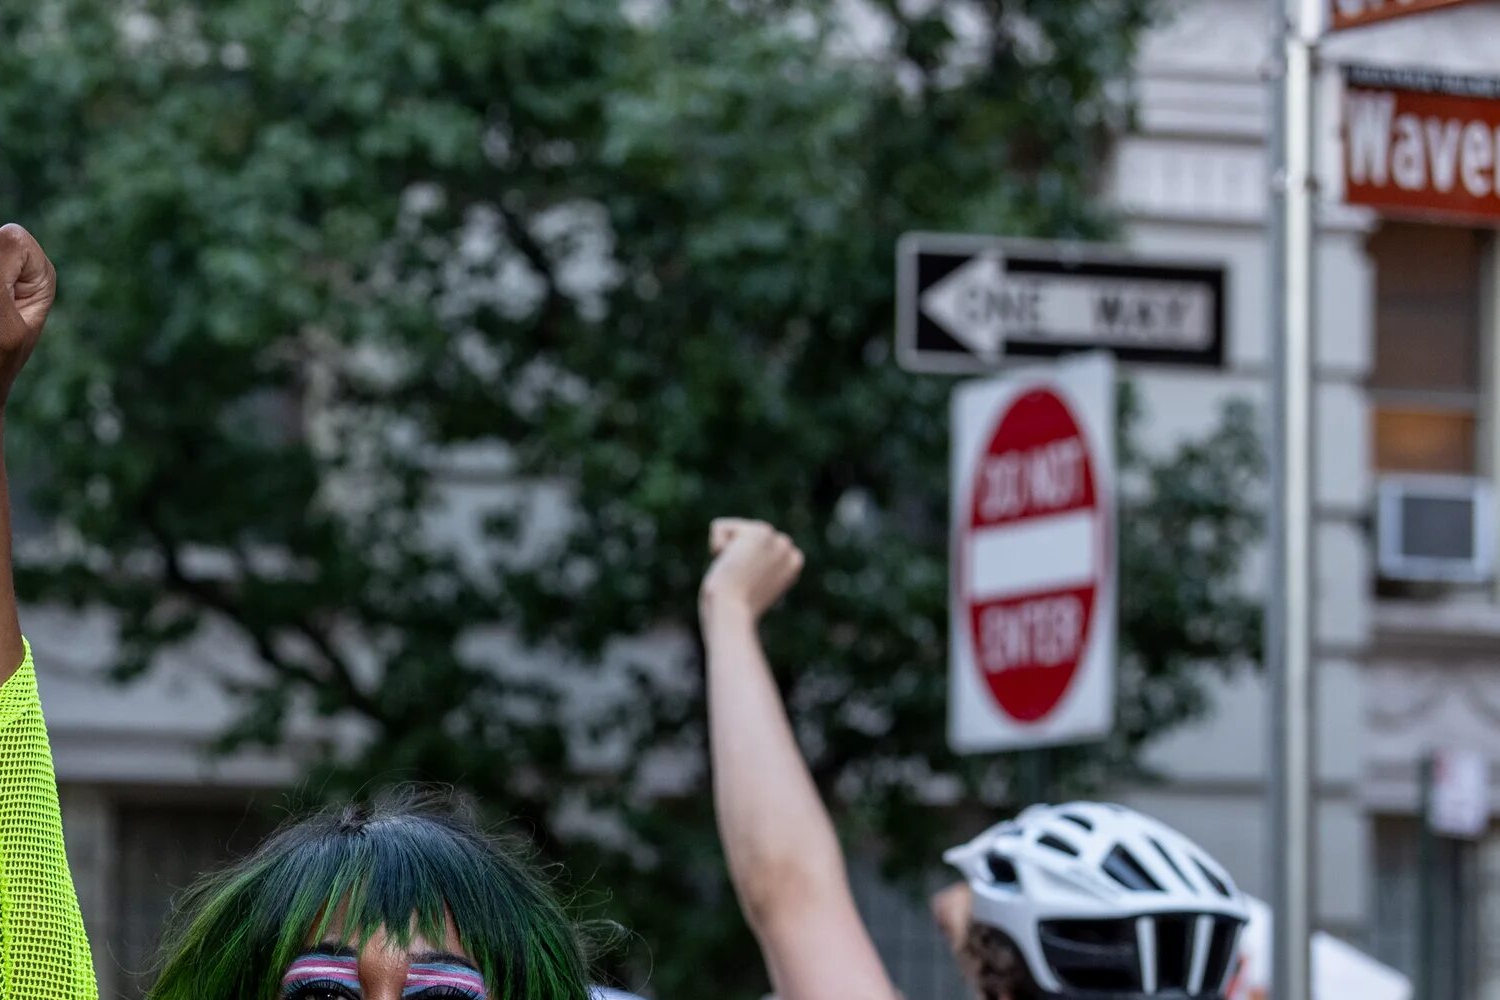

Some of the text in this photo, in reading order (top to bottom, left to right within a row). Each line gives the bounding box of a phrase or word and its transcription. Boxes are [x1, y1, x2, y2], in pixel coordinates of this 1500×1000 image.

[954, 281, 1196, 340] ONE WAY
[1030, 437, 1085, 507] NOT
[981, 592, 1083, 673] ENTER
